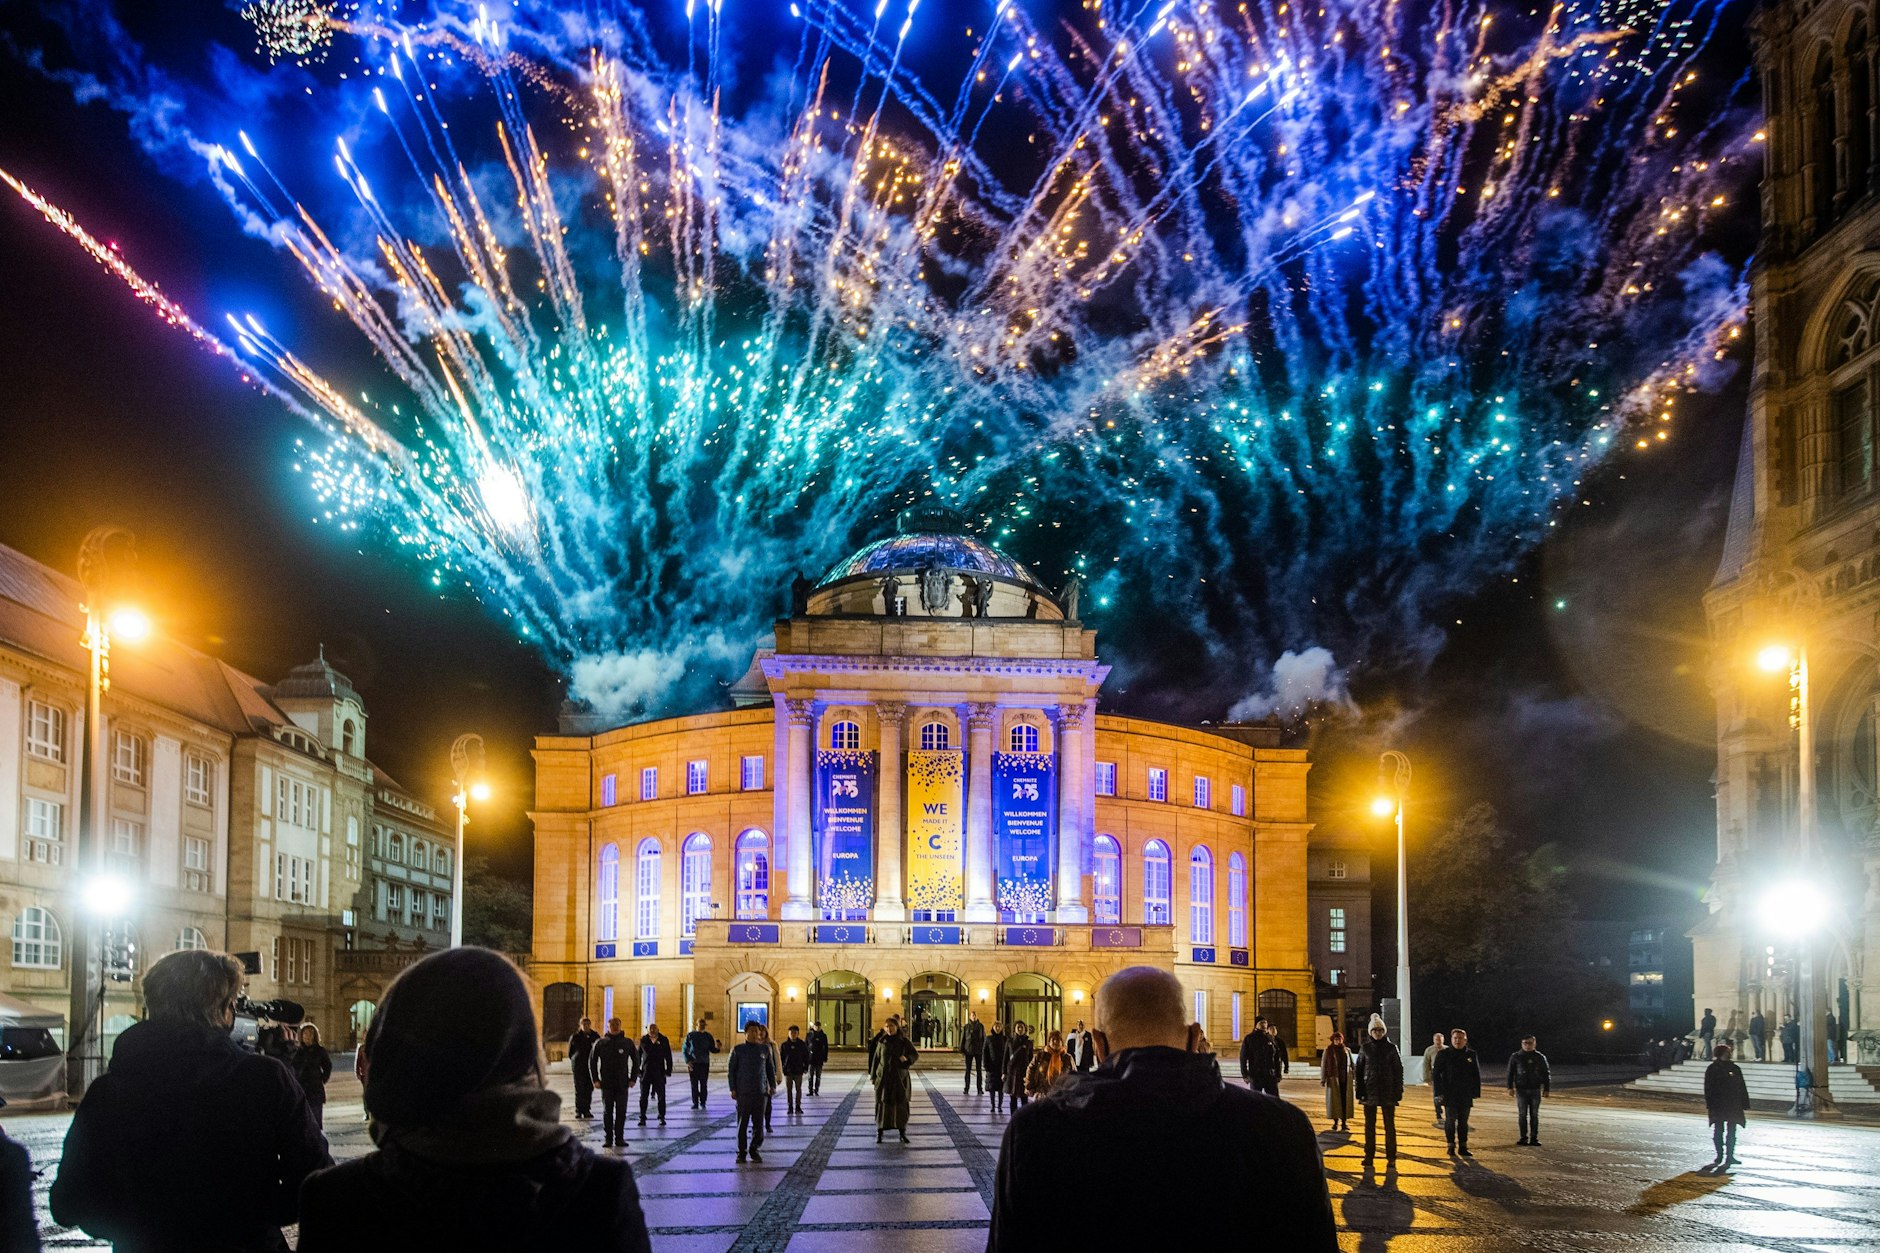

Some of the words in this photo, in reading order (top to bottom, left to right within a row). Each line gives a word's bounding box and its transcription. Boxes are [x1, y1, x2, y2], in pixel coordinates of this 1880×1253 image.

[824, 807, 868, 815] WILLKOMMEN
[923, 803, 948, 815] WE
[1003, 810, 1047, 818] WILLKOMMEN
[827, 816, 864, 824] BIENVENUE
[1007, 819, 1043, 827] BIENVENUE
[1009, 828, 1041, 836] WELCOME
[928, 834, 942, 850] C
[832, 852, 859, 860] EUROPA
